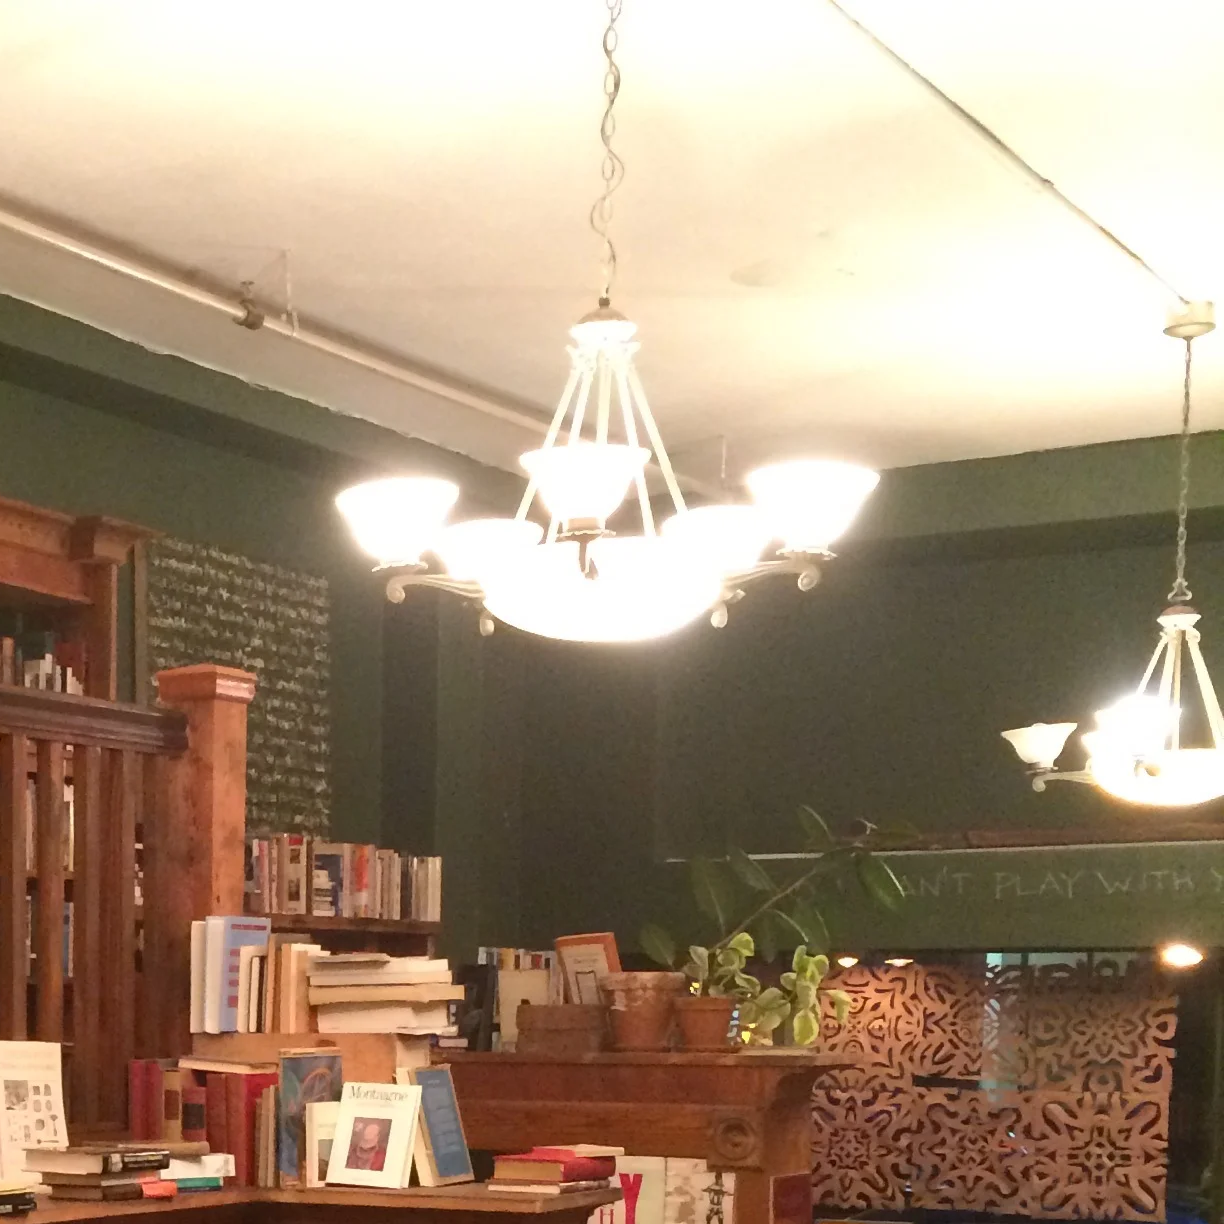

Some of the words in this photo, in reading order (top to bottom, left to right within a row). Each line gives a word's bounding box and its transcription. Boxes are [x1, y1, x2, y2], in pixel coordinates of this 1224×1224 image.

[898, 866, 973, 898] AN'T
[995, 870, 1080, 899] PLAY
[1097, 869, 1196, 894] WITH
[349, 1085, 409, 1102] Montaigne
